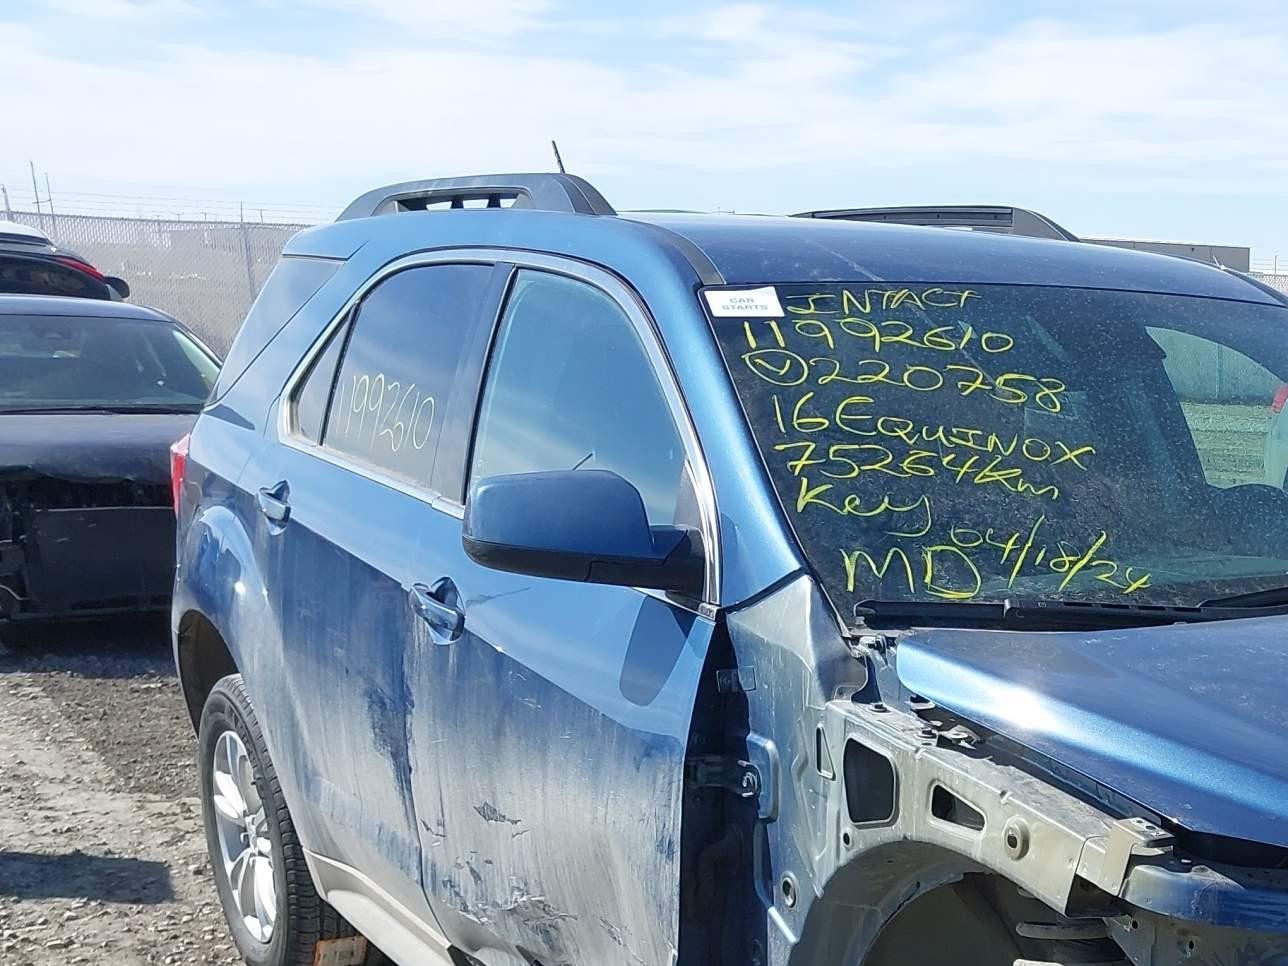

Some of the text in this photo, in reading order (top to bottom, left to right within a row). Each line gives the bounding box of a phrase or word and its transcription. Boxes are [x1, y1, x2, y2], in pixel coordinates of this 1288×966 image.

[785, 288, 982, 314] INTACT
[743, 317, 1014, 353] 11992610
[338, 373, 435, 452] 11992610
[810, 357, 1066, 413] 220758
[797, 477, 932, 538] Key
[840, 513, 1152, 600] MD 04/18/24
